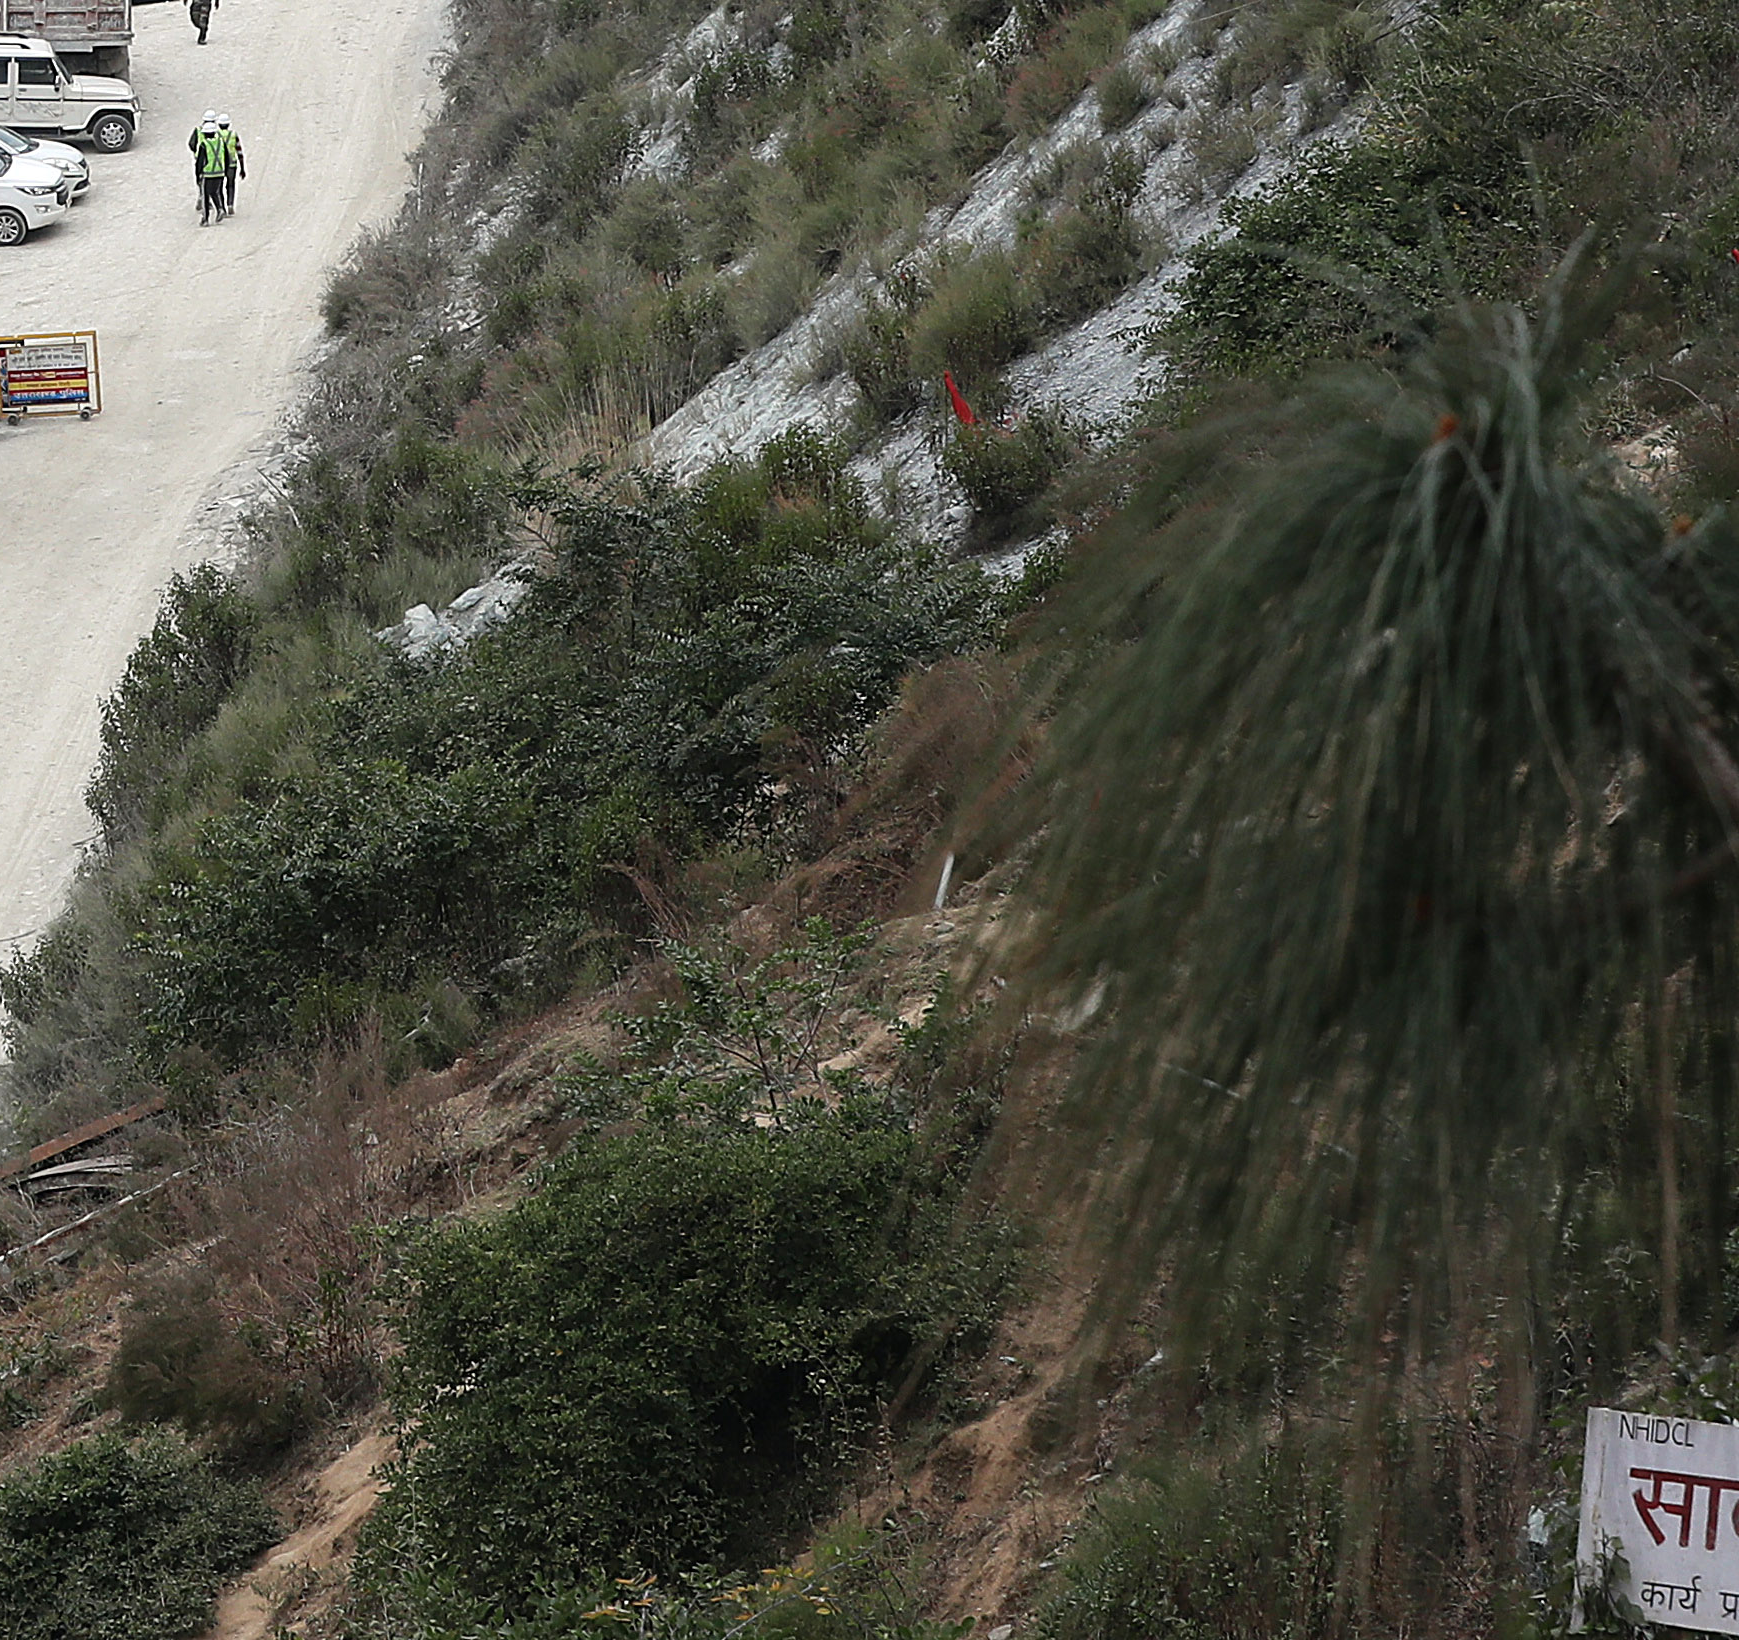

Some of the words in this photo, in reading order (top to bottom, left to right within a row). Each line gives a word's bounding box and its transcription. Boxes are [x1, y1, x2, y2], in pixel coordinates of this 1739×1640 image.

[1619, 1414, 1694, 1448] NHIDCL
[1629, 1467, 1739, 1552] सा
[1641, 1575, 1702, 1614] कार्य
